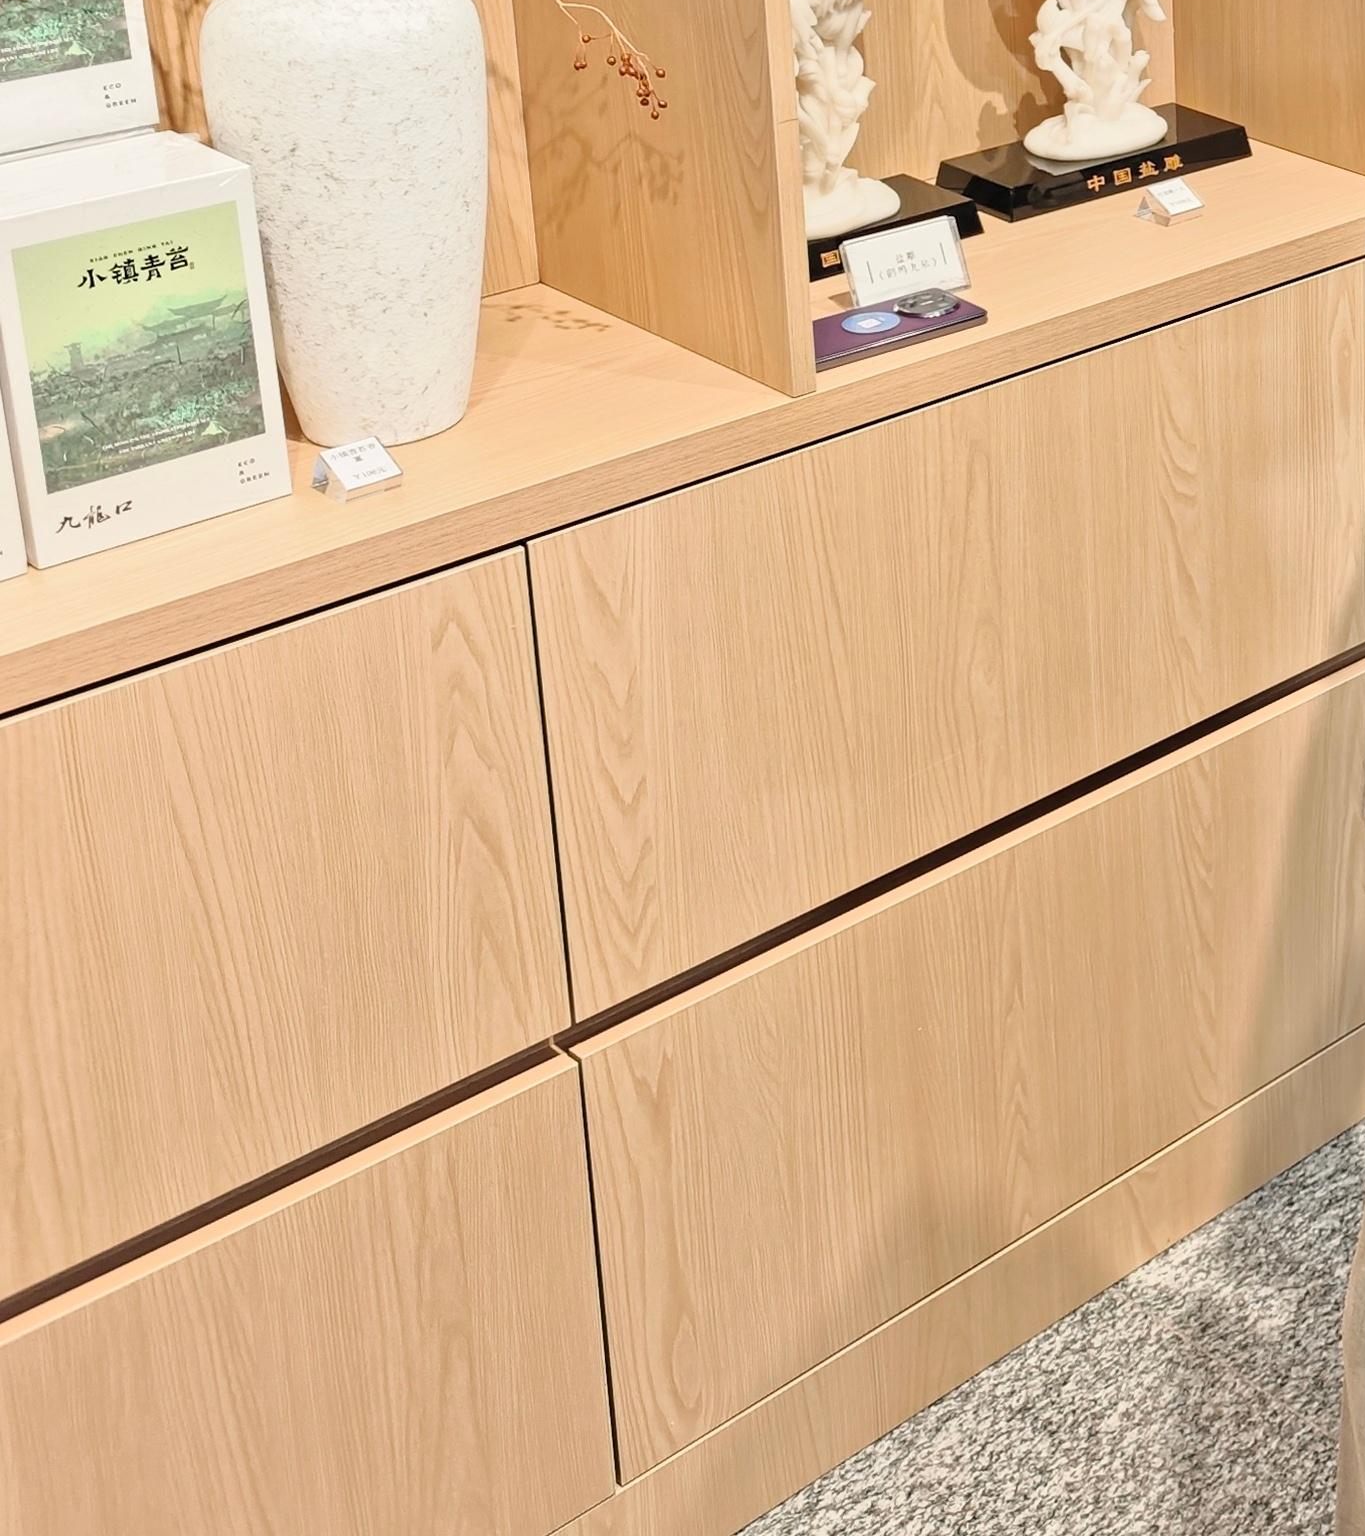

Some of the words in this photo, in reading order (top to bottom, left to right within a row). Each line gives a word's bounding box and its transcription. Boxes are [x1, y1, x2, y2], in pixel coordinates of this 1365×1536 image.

[103, 82, 122, 91] ECO
[105, 98, 137, 109] GREEN
[1086, 153, 1185, 193] 中国盐雕
[76, 245, 190, 289] 小镇青苔
[237, 457, 256, 468] ECO
[239, 471, 270, 485] GREEN
